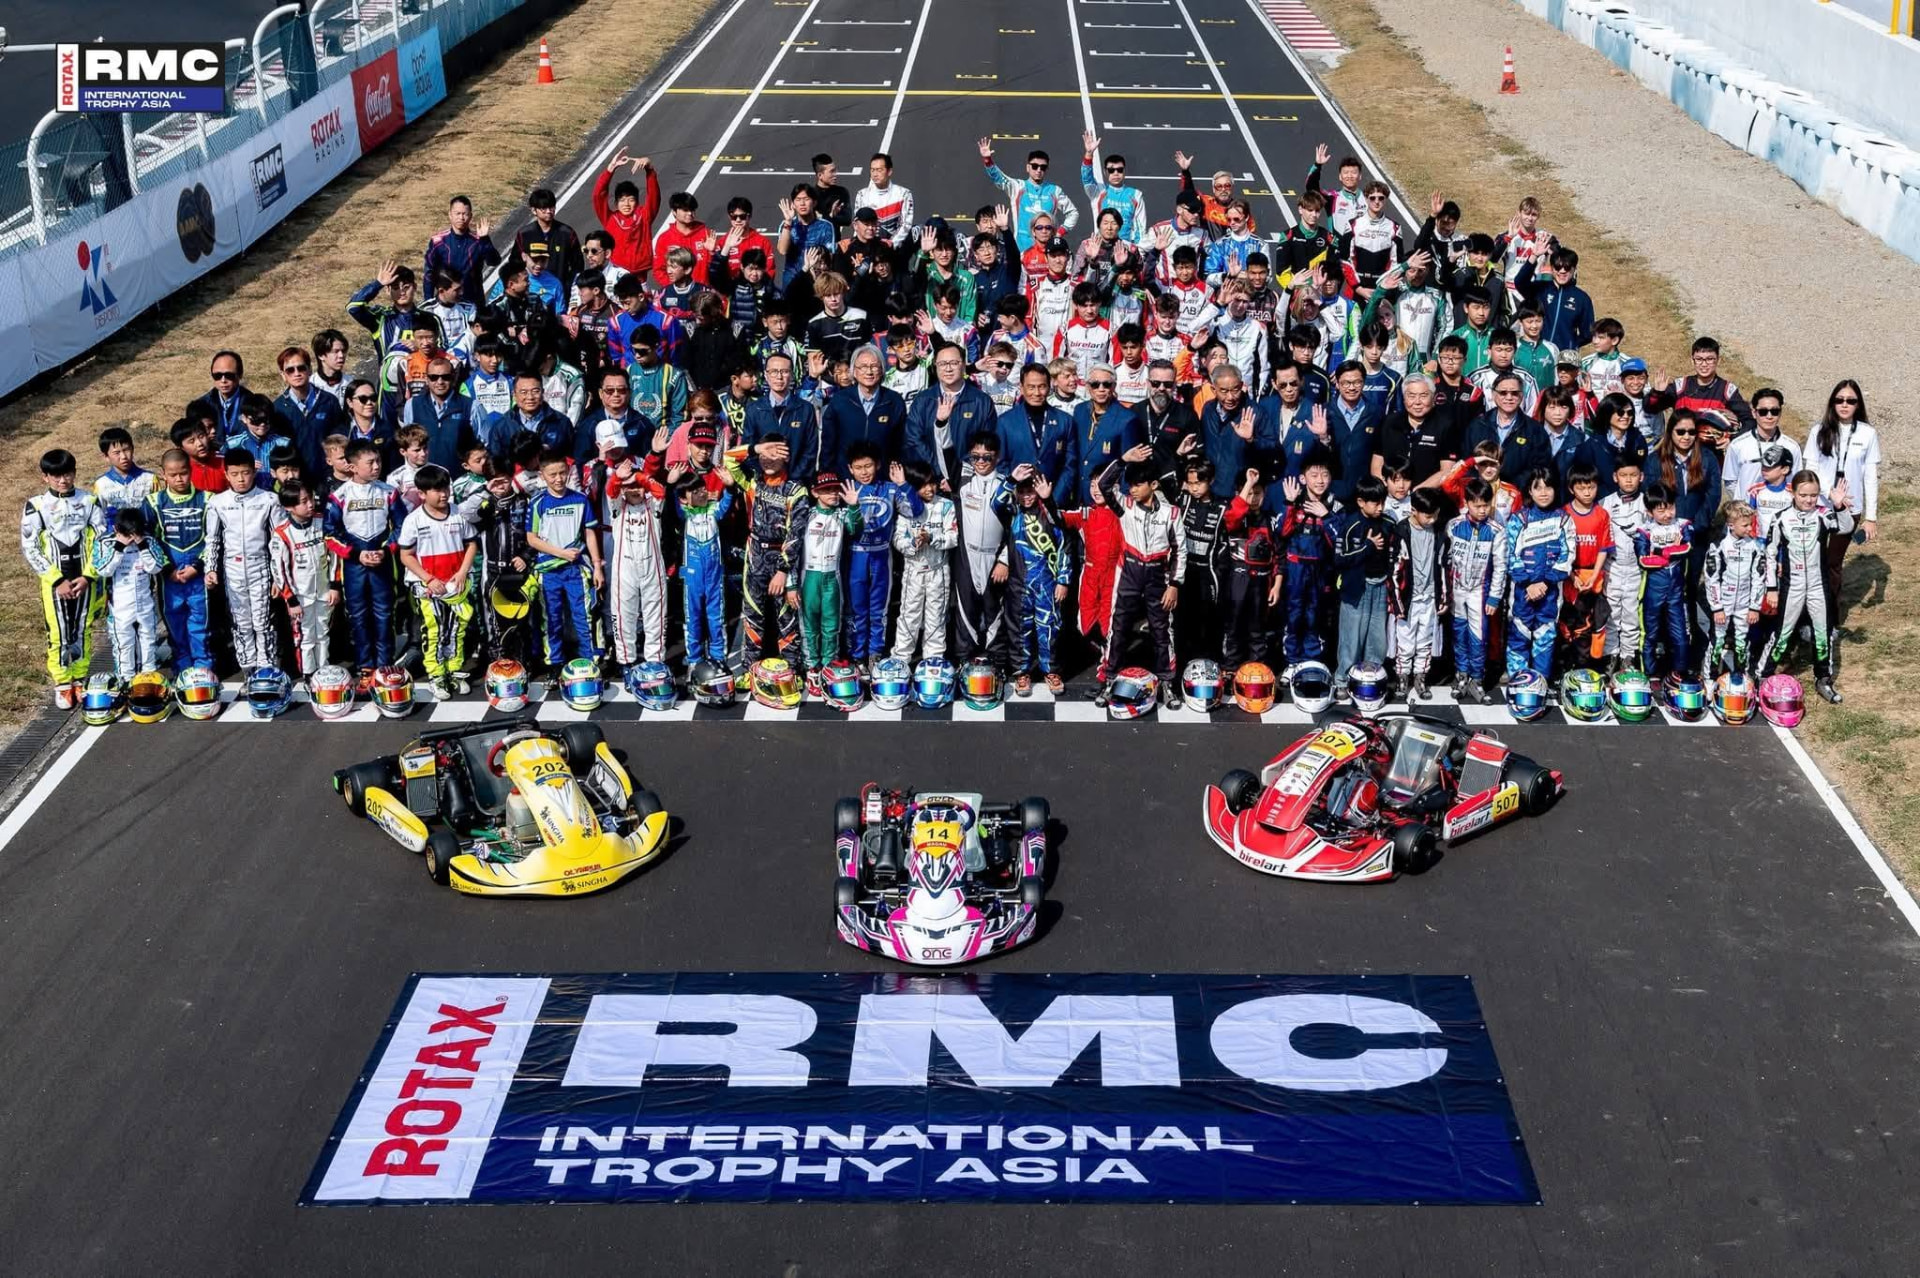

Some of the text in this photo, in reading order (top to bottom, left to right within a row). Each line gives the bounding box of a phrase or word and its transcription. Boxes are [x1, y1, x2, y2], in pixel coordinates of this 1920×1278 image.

[311, 107, 343, 149] ROTAX
[316, 134, 345, 163] RACING
[256, 149, 282, 186] RMC
[1575, 534, 1597, 542] OTAX
[532, 762, 567, 778] 202
[366, 798, 384, 820] 202
[1496, 793, 1518, 814] 507
[546, 818, 565, 844] SINGHA
[927, 828, 950, 840] 14
[1450, 811, 1492, 837] birelart
[1238, 849, 1288, 873] birelart
[576, 876, 609, 890] SINGHA
[561, 994, 1448, 1092] RMC
[362, 1002, 507, 1177] ROTAX
[539, 1124, 1255, 1153] INTERNATIONAL
[533, 1156, 1150, 1184] TROPHY ASIA
